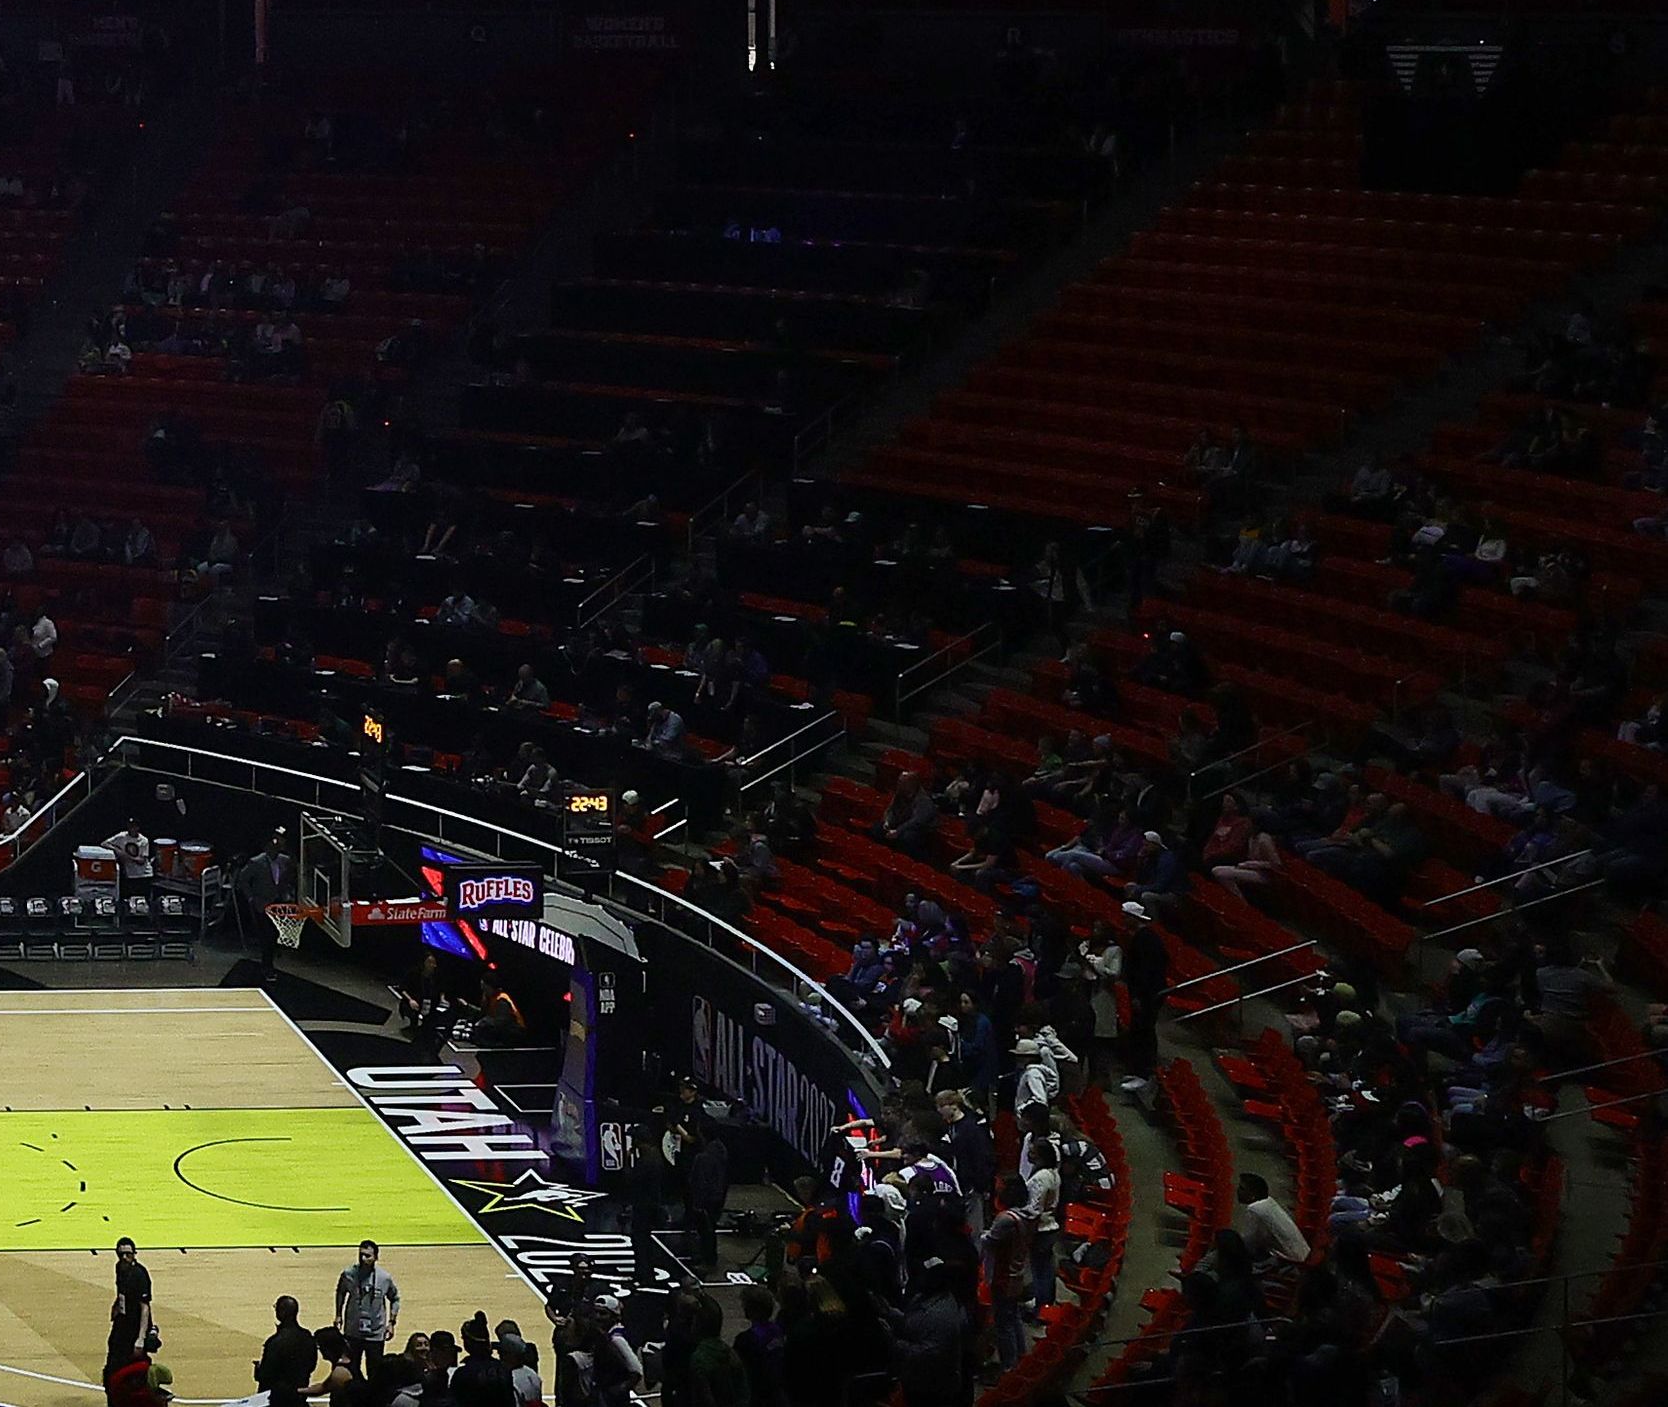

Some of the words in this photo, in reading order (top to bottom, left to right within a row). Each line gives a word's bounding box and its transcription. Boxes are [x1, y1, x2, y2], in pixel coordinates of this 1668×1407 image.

[571, 795, 608, 811] 22:43
[461, 878, 533, 907] RUFFLES
[346, 1064, 551, 1161] UTAH
